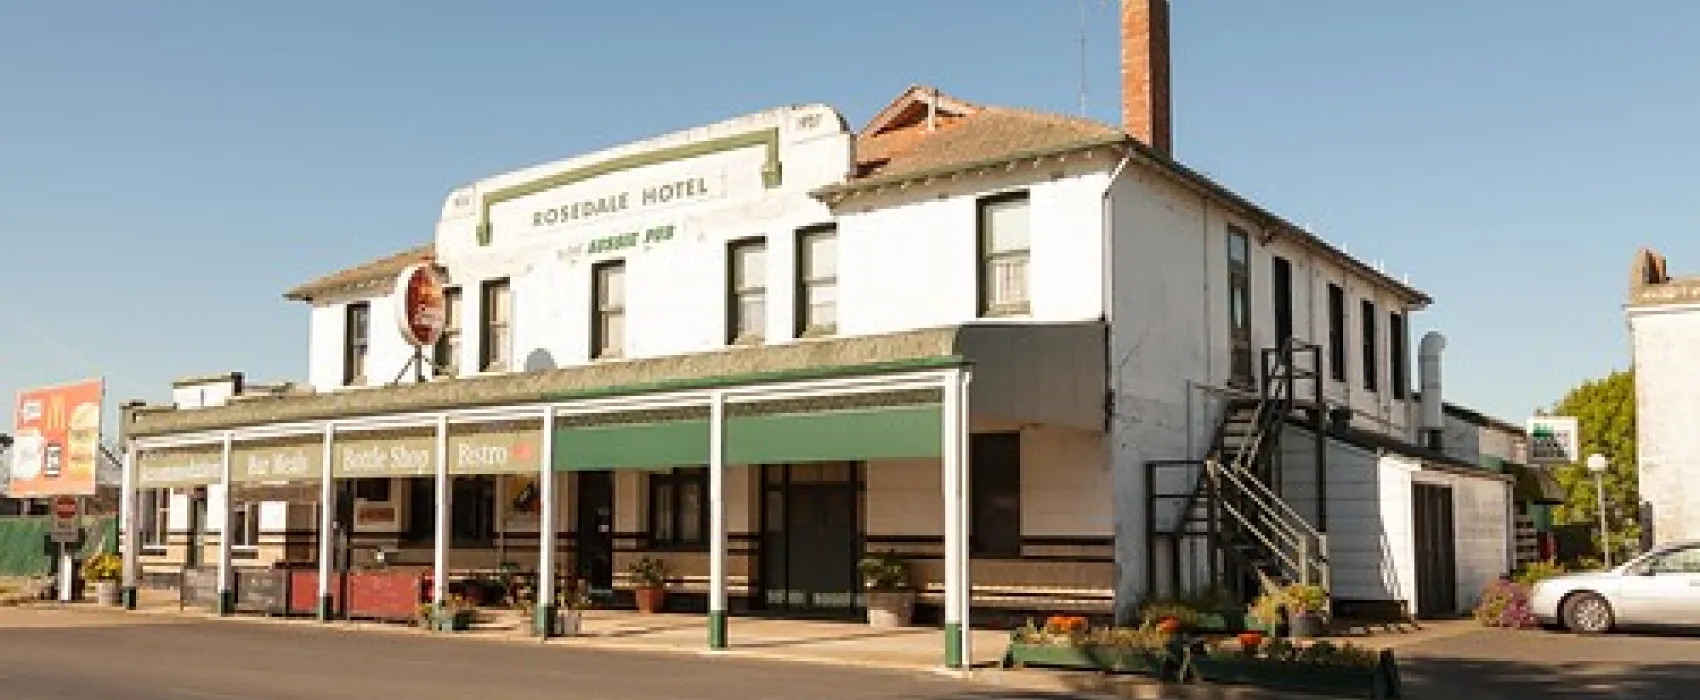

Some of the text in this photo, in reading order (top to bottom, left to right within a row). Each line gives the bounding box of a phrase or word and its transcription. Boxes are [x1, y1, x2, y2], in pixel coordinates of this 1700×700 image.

[533, 177, 708, 227] ROSEDALE HOTEL
[342, 443, 430, 475] Bottle Shop
[458, 441, 508, 468] Bistro
